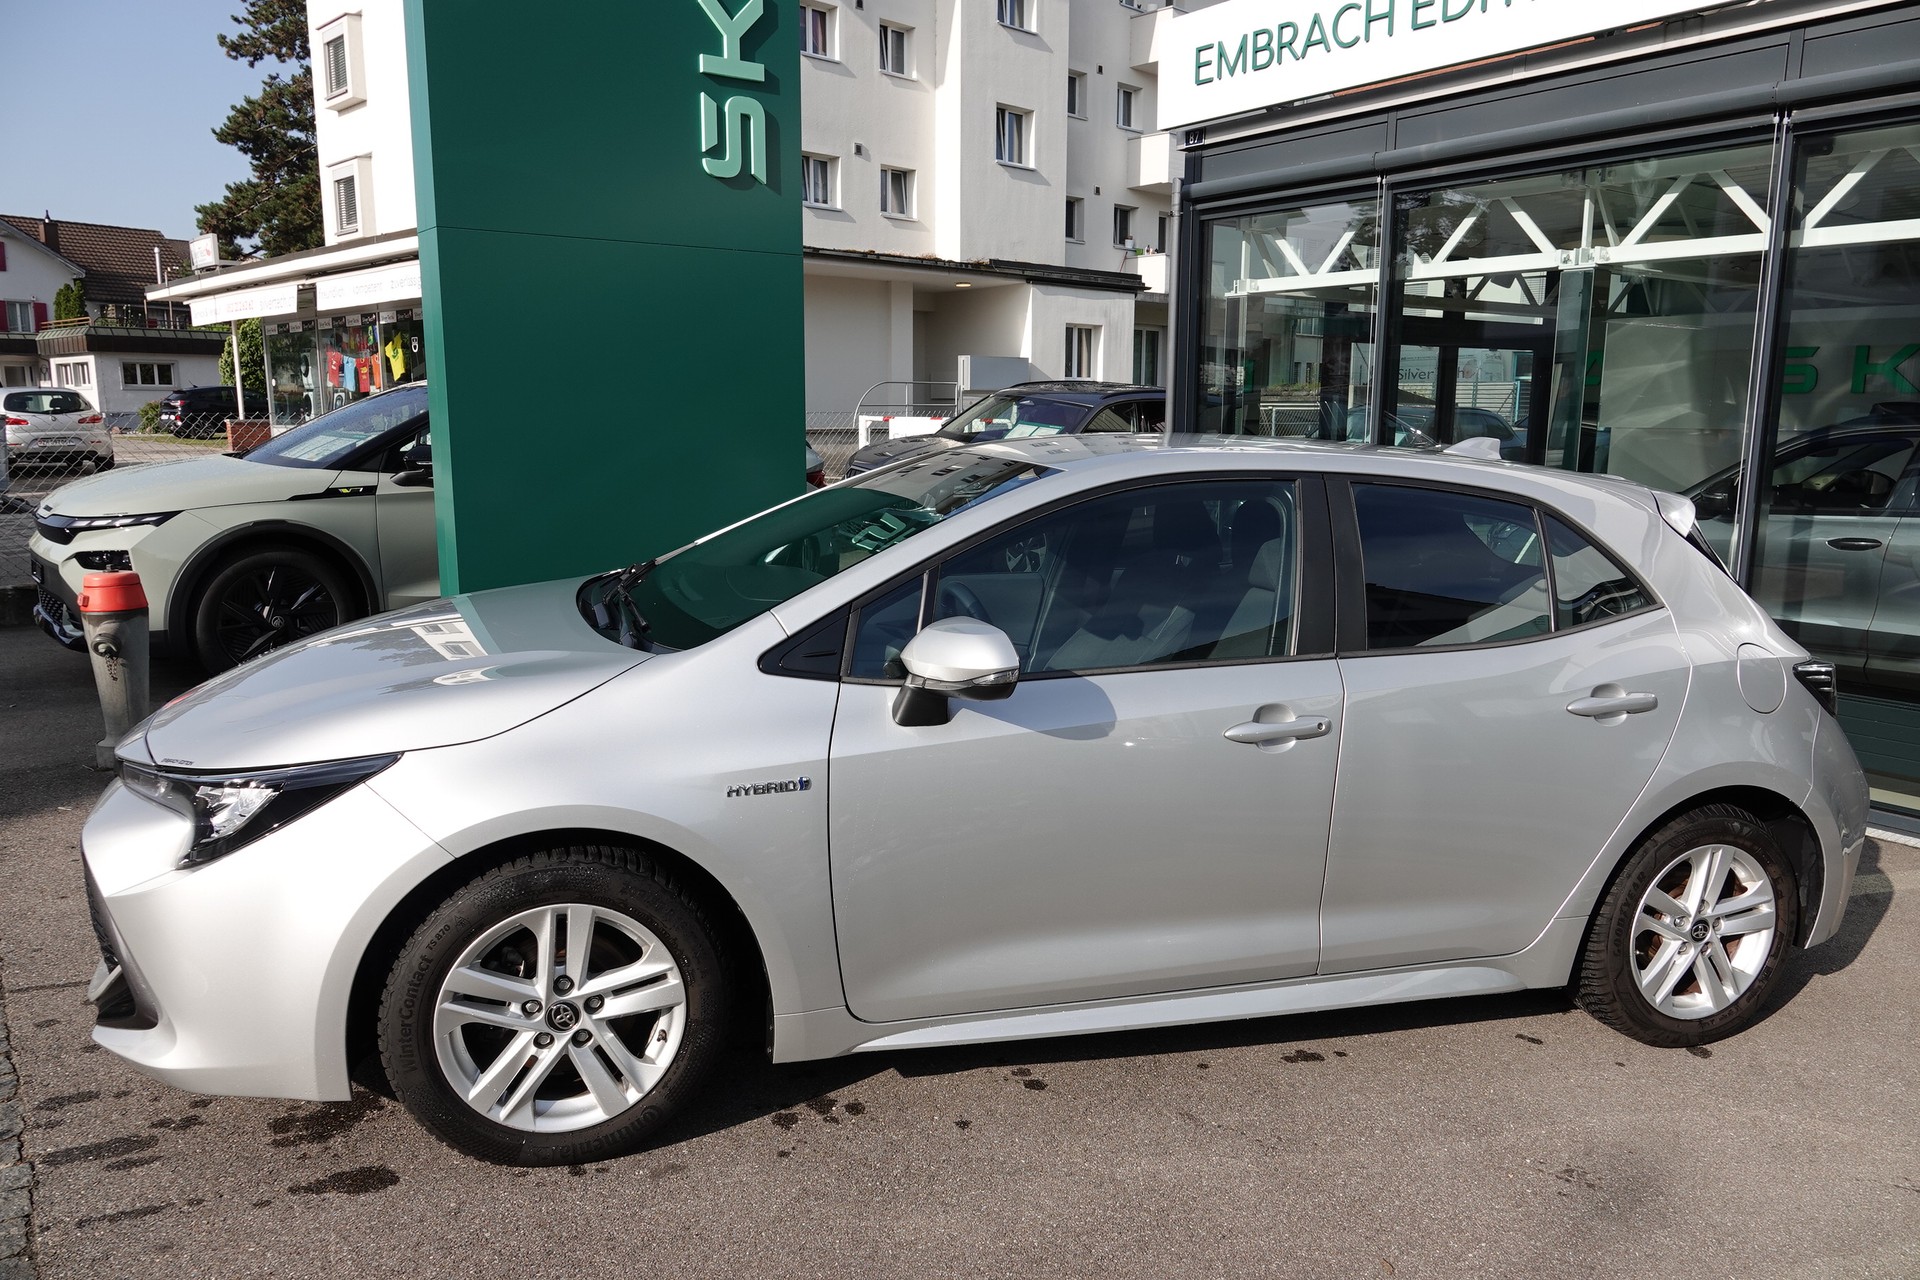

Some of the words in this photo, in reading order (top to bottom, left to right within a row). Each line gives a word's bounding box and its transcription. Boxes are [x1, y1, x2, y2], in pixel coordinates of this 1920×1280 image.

[1193, 0, 1396, 86] EMBRACH
[1189, 131, 1200, 144] 87
[727, 780, 799, 798] HYBRID
[398, 954, 434, 1073] WinterContact
[426, 938, 437, 951] TS
[435, 924, 451, 941] 870
